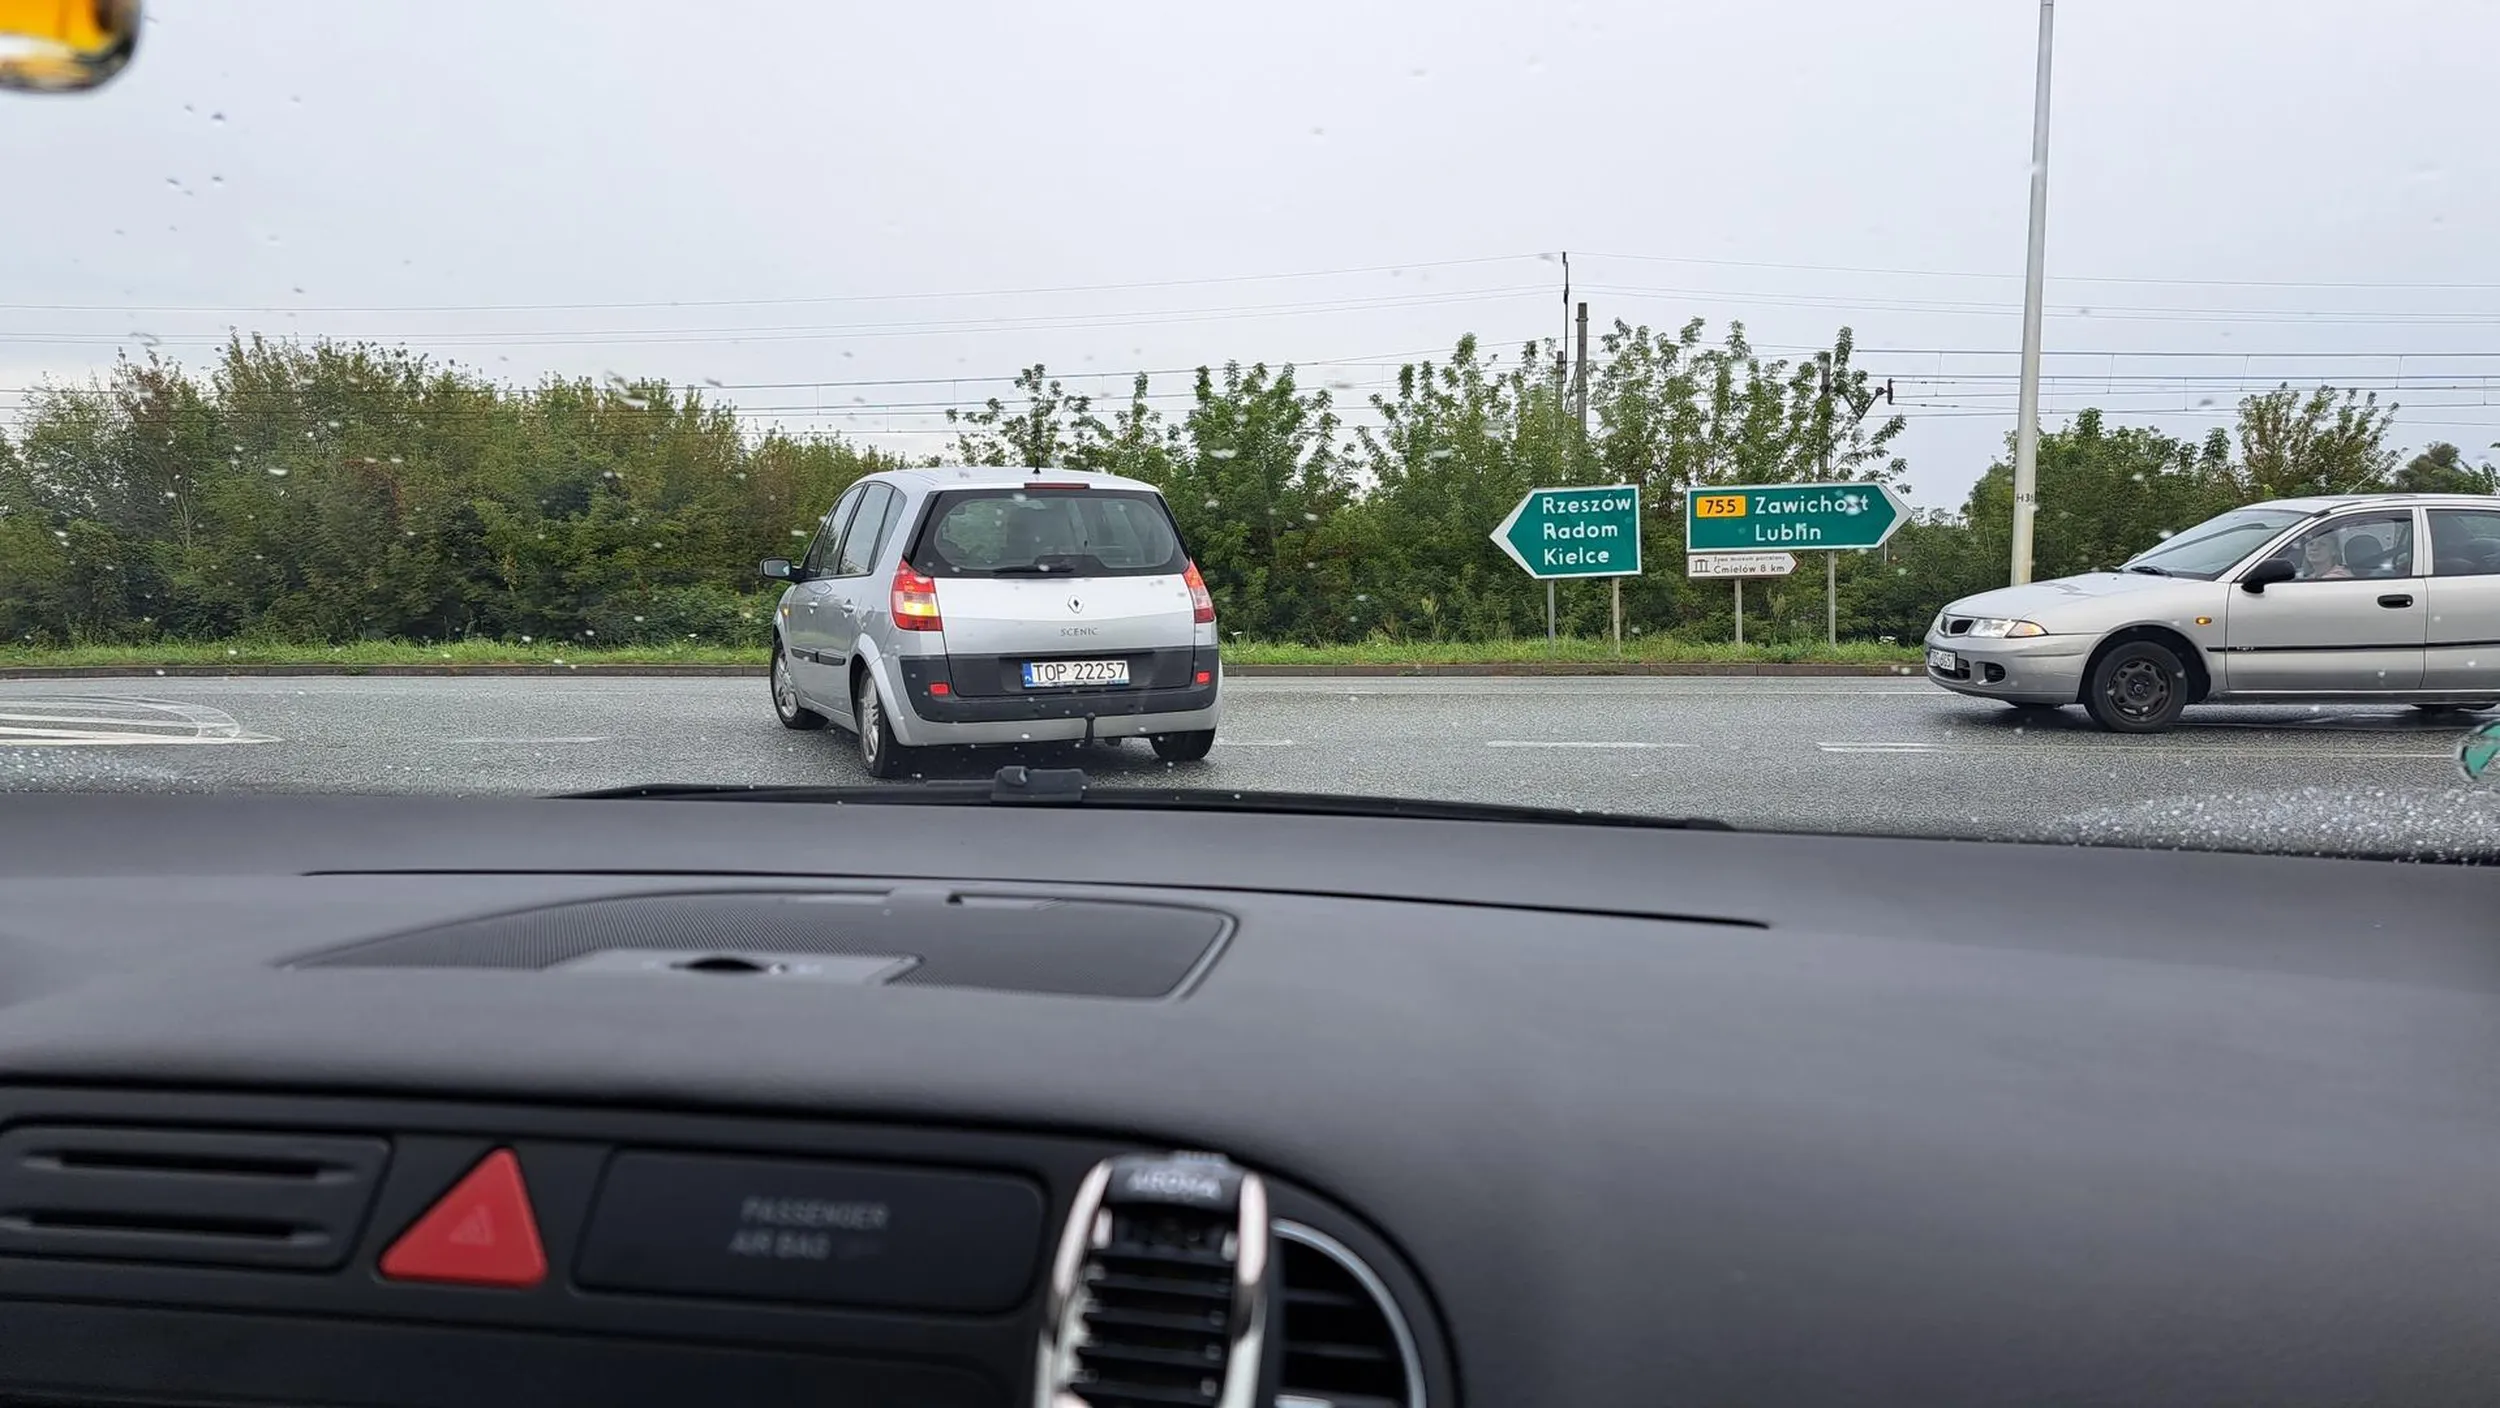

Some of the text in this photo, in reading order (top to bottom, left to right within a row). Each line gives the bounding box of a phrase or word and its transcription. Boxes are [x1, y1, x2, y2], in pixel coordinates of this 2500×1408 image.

[1542, 493, 1631, 514] Rzeszów
[1705, 499, 1737, 514] 755
[1755, 494, 1869, 515] Zawichost
[1543, 521, 1618, 540] Radom
[1755, 522, 1822, 541] Lublin
[1544, 547, 1610, 566] Kielce
[1760, 564, 1767, 573] 8
[1770, 563, 1785, 572] km
[1060, 627, 1099, 637] SCENIC
[1033, 664, 1067, 681] TOP
[1073, 662, 1126, 680] 22257
[741, 1197, 891, 1229] PASSENGER
[727, 1229, 773, 1257] AIR
